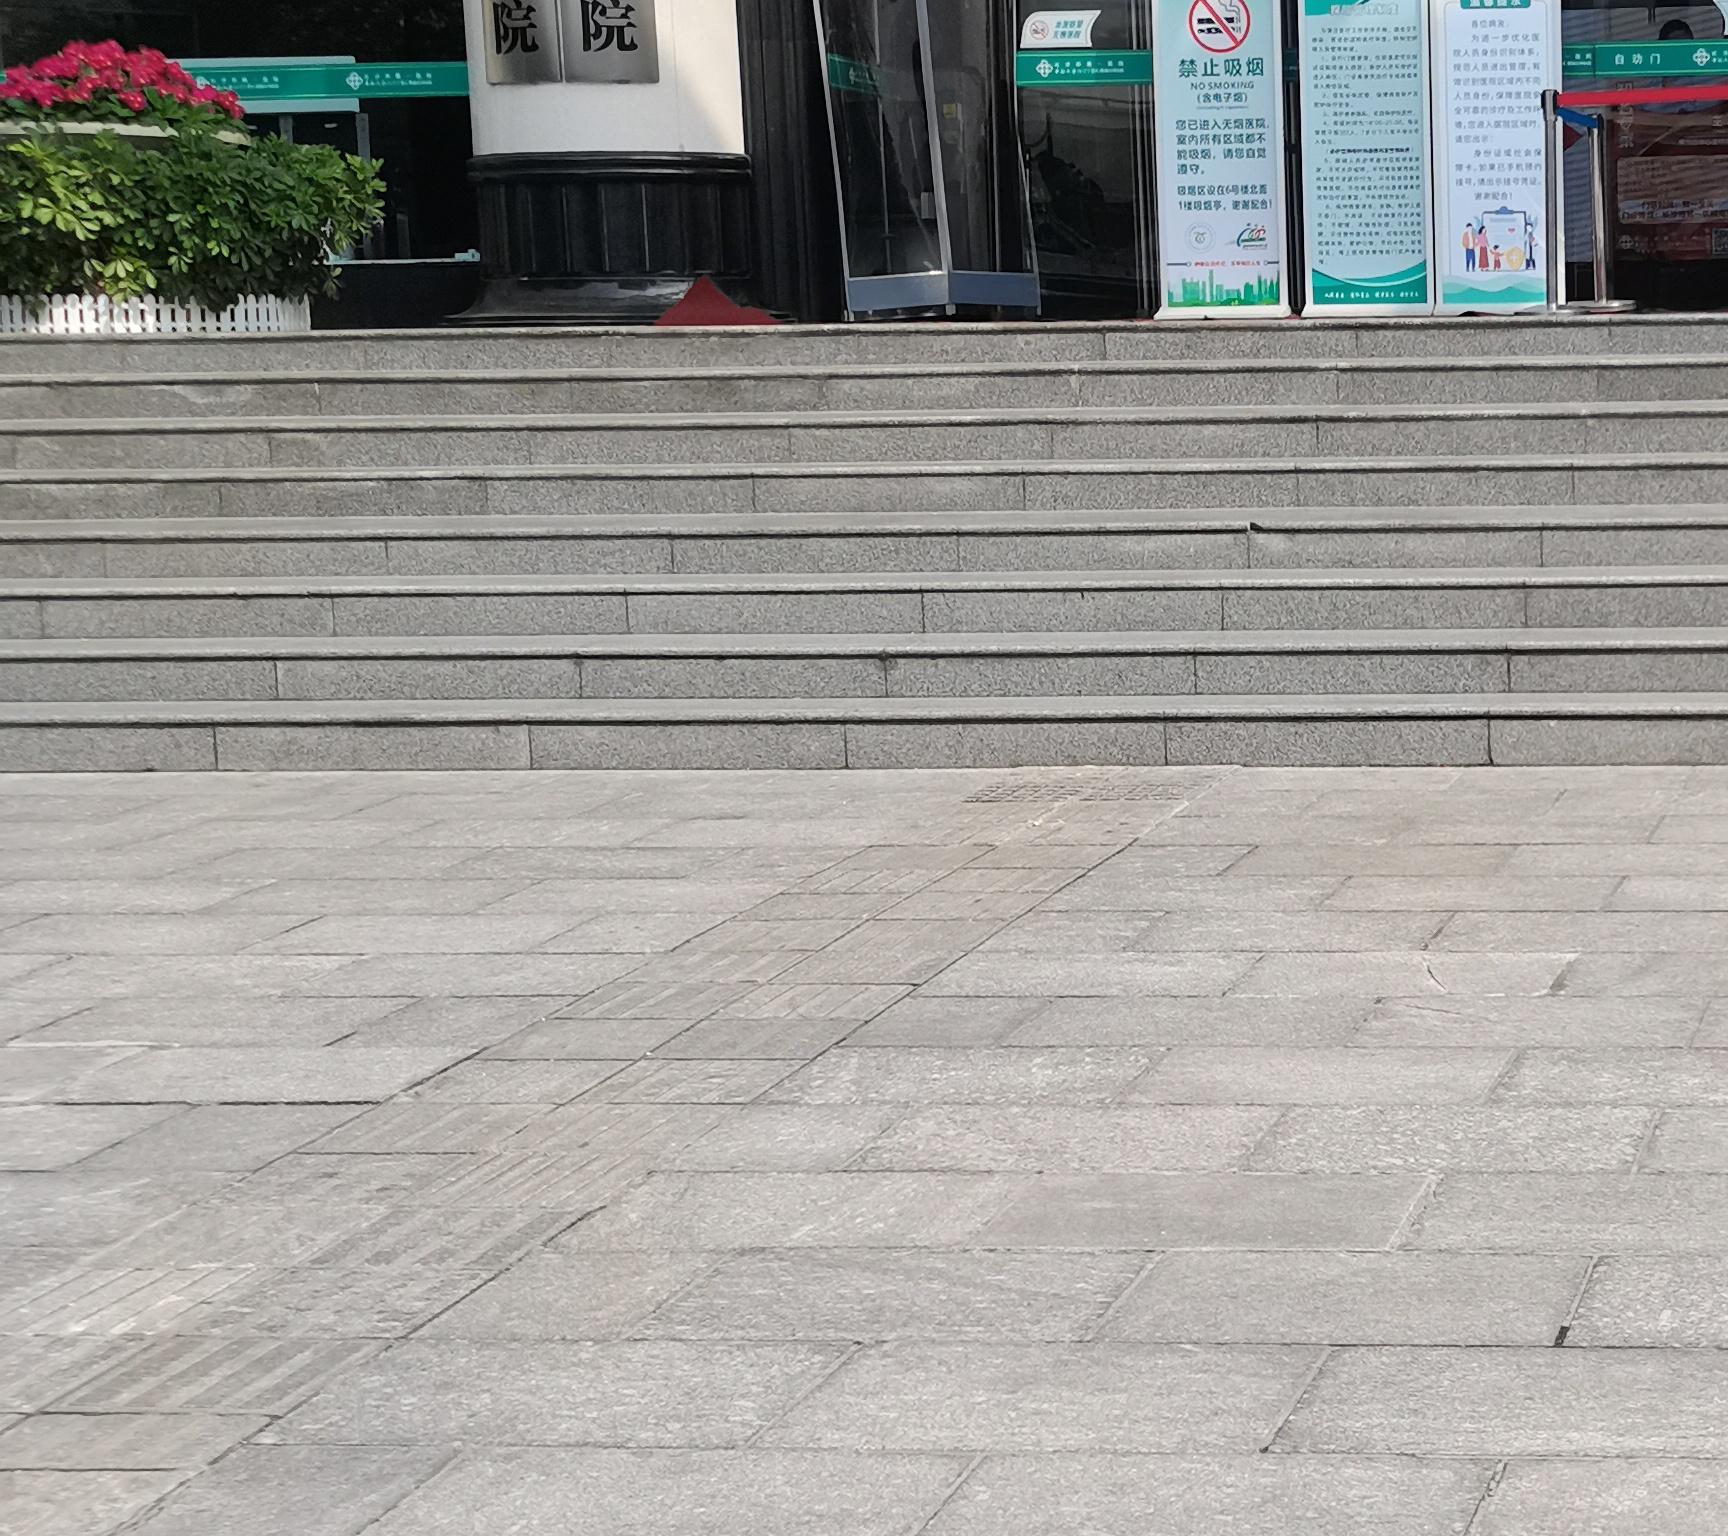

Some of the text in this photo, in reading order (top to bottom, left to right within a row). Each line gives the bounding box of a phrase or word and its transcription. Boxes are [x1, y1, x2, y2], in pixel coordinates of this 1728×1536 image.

[1614, 53, 1661, 66] 自动门
[1178, 57, 1264, 79] 禁止吸烟
[1190, 80, 1255, 91] NO SMOKING
[1176, 132, 1267, 146] 室内所有区域都不
